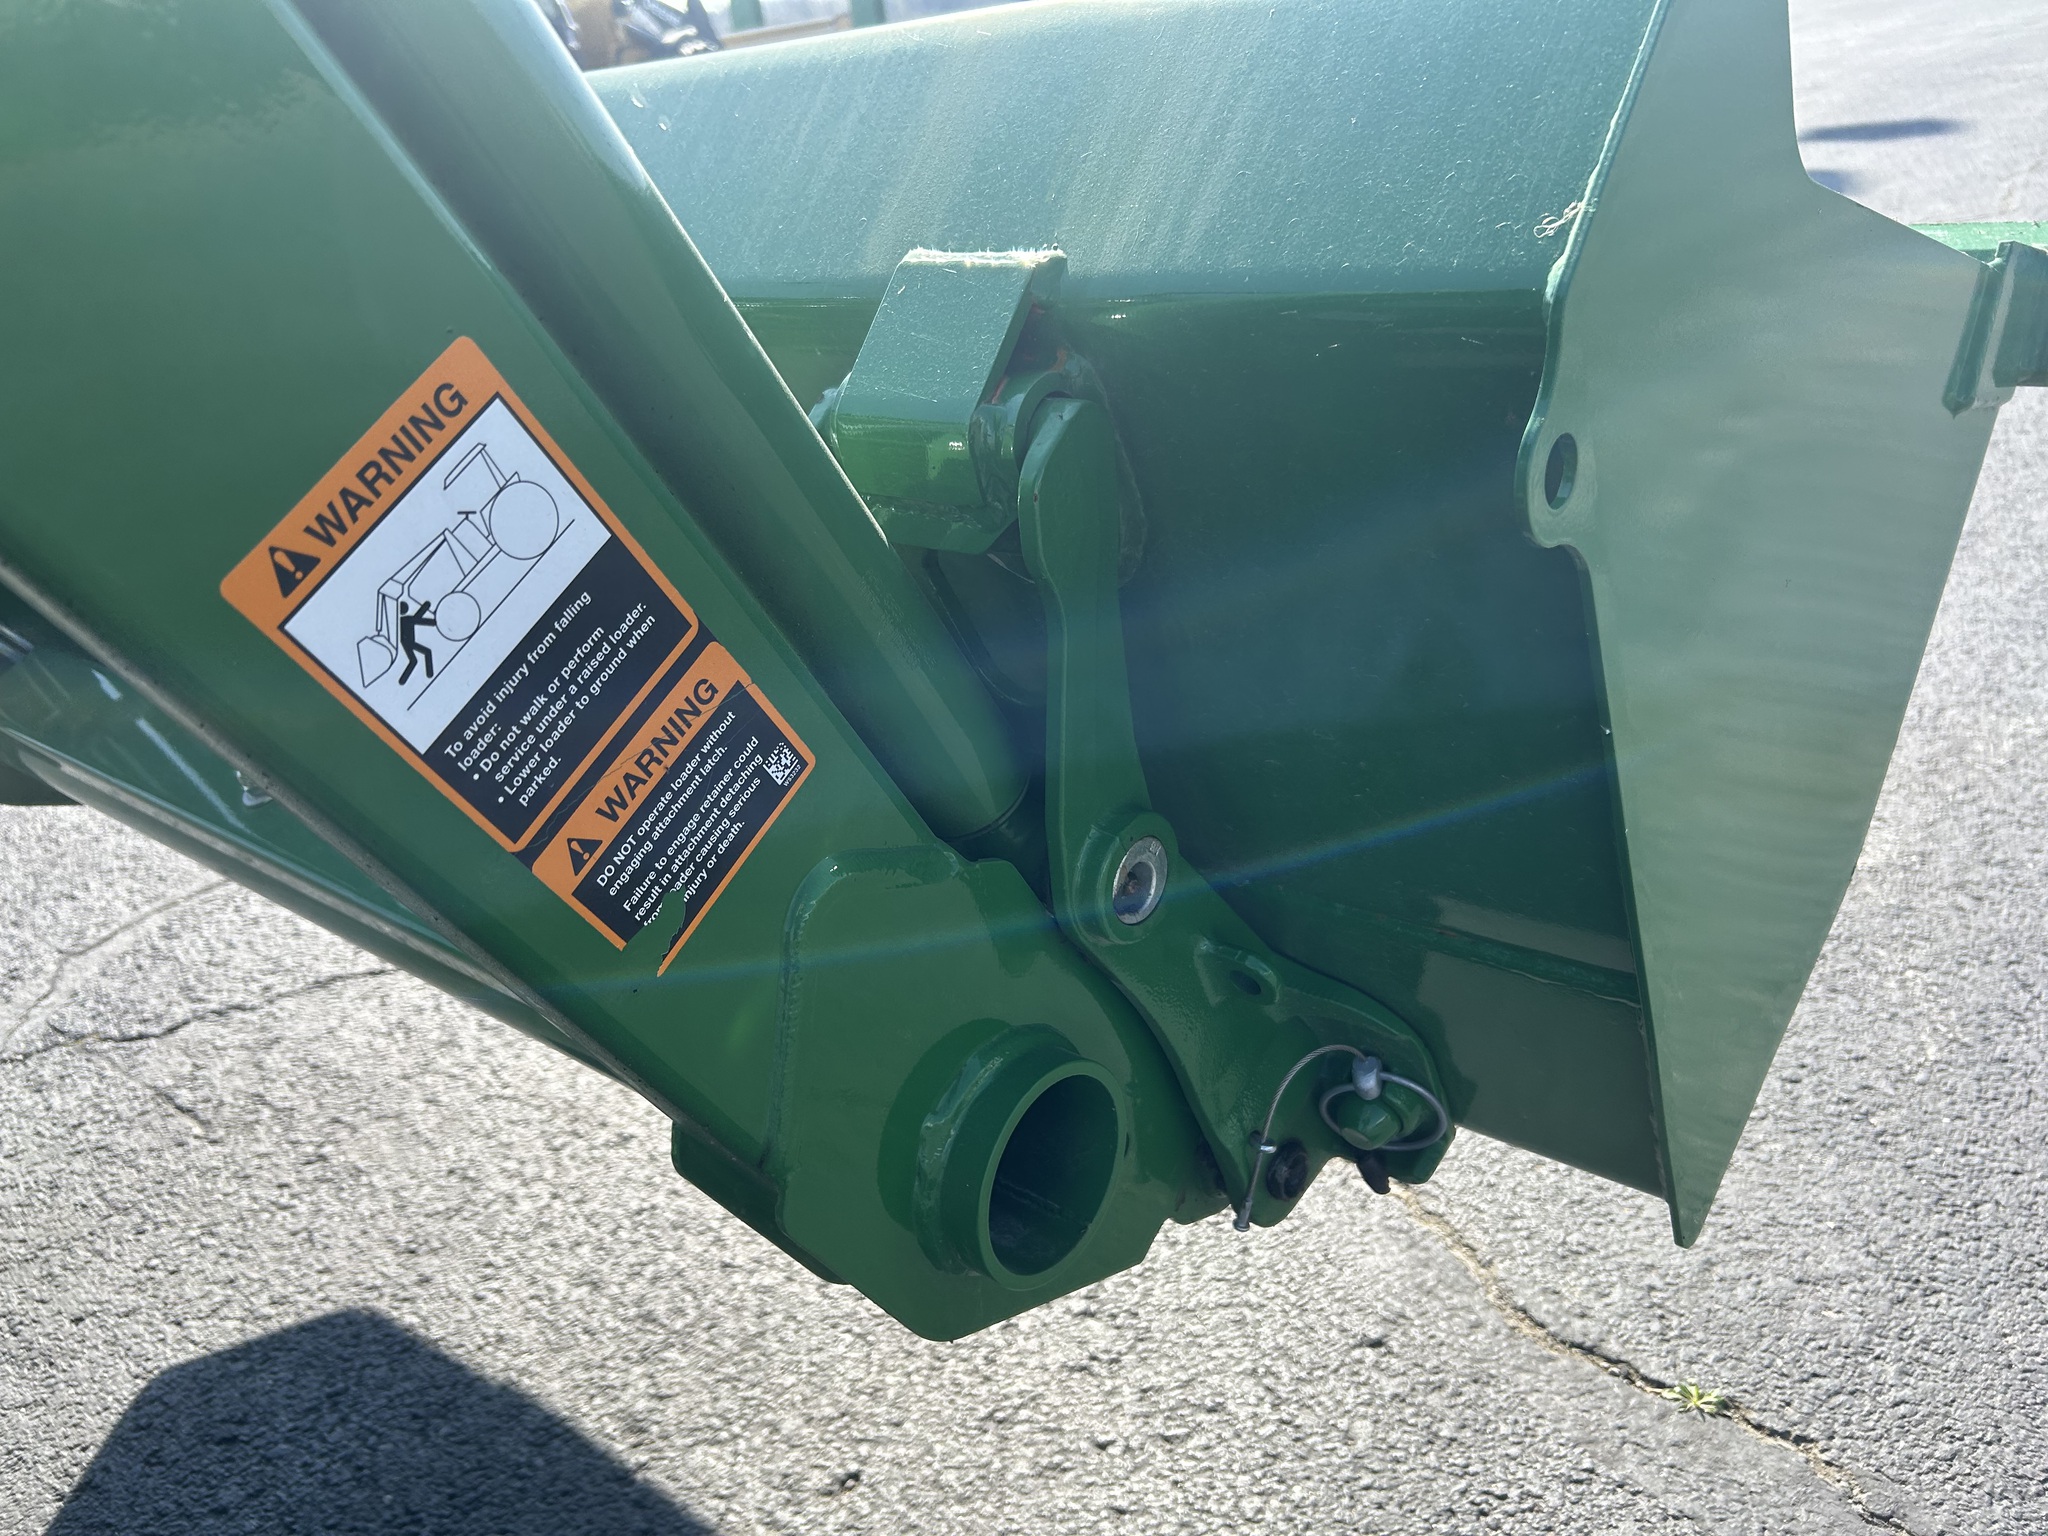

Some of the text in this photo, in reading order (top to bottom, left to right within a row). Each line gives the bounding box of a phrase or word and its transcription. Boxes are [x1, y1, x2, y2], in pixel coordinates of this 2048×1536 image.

[303, 382, 469, 548] WARNING
[444, 591, 592, 757] To avoid injury from falling
[457, 723, 502, 772] loader:
[479, 627, 605, 772] Do not walk or perform
[494, 602, 647, 783] service under a raised loader.
[503, 615, 656, 795] Lower loader to ground when
[595, 678, 719, 823] WARNING
[518, 756, 562, 807] parked.
[596, 711, 736, 887] DO NOT operate loader without
[609, 746, 728, 896] engaging attachment latch.
[622, 736, 759, 912] Failure to engage retainer could
[634, 754, 764, 921] result in attachment detaching
[695, 817, 731, 863] causing
[728, 777, 761, 818] serious
[706, 853, 717, 869] or
[717, 821, 745, 855] death.
